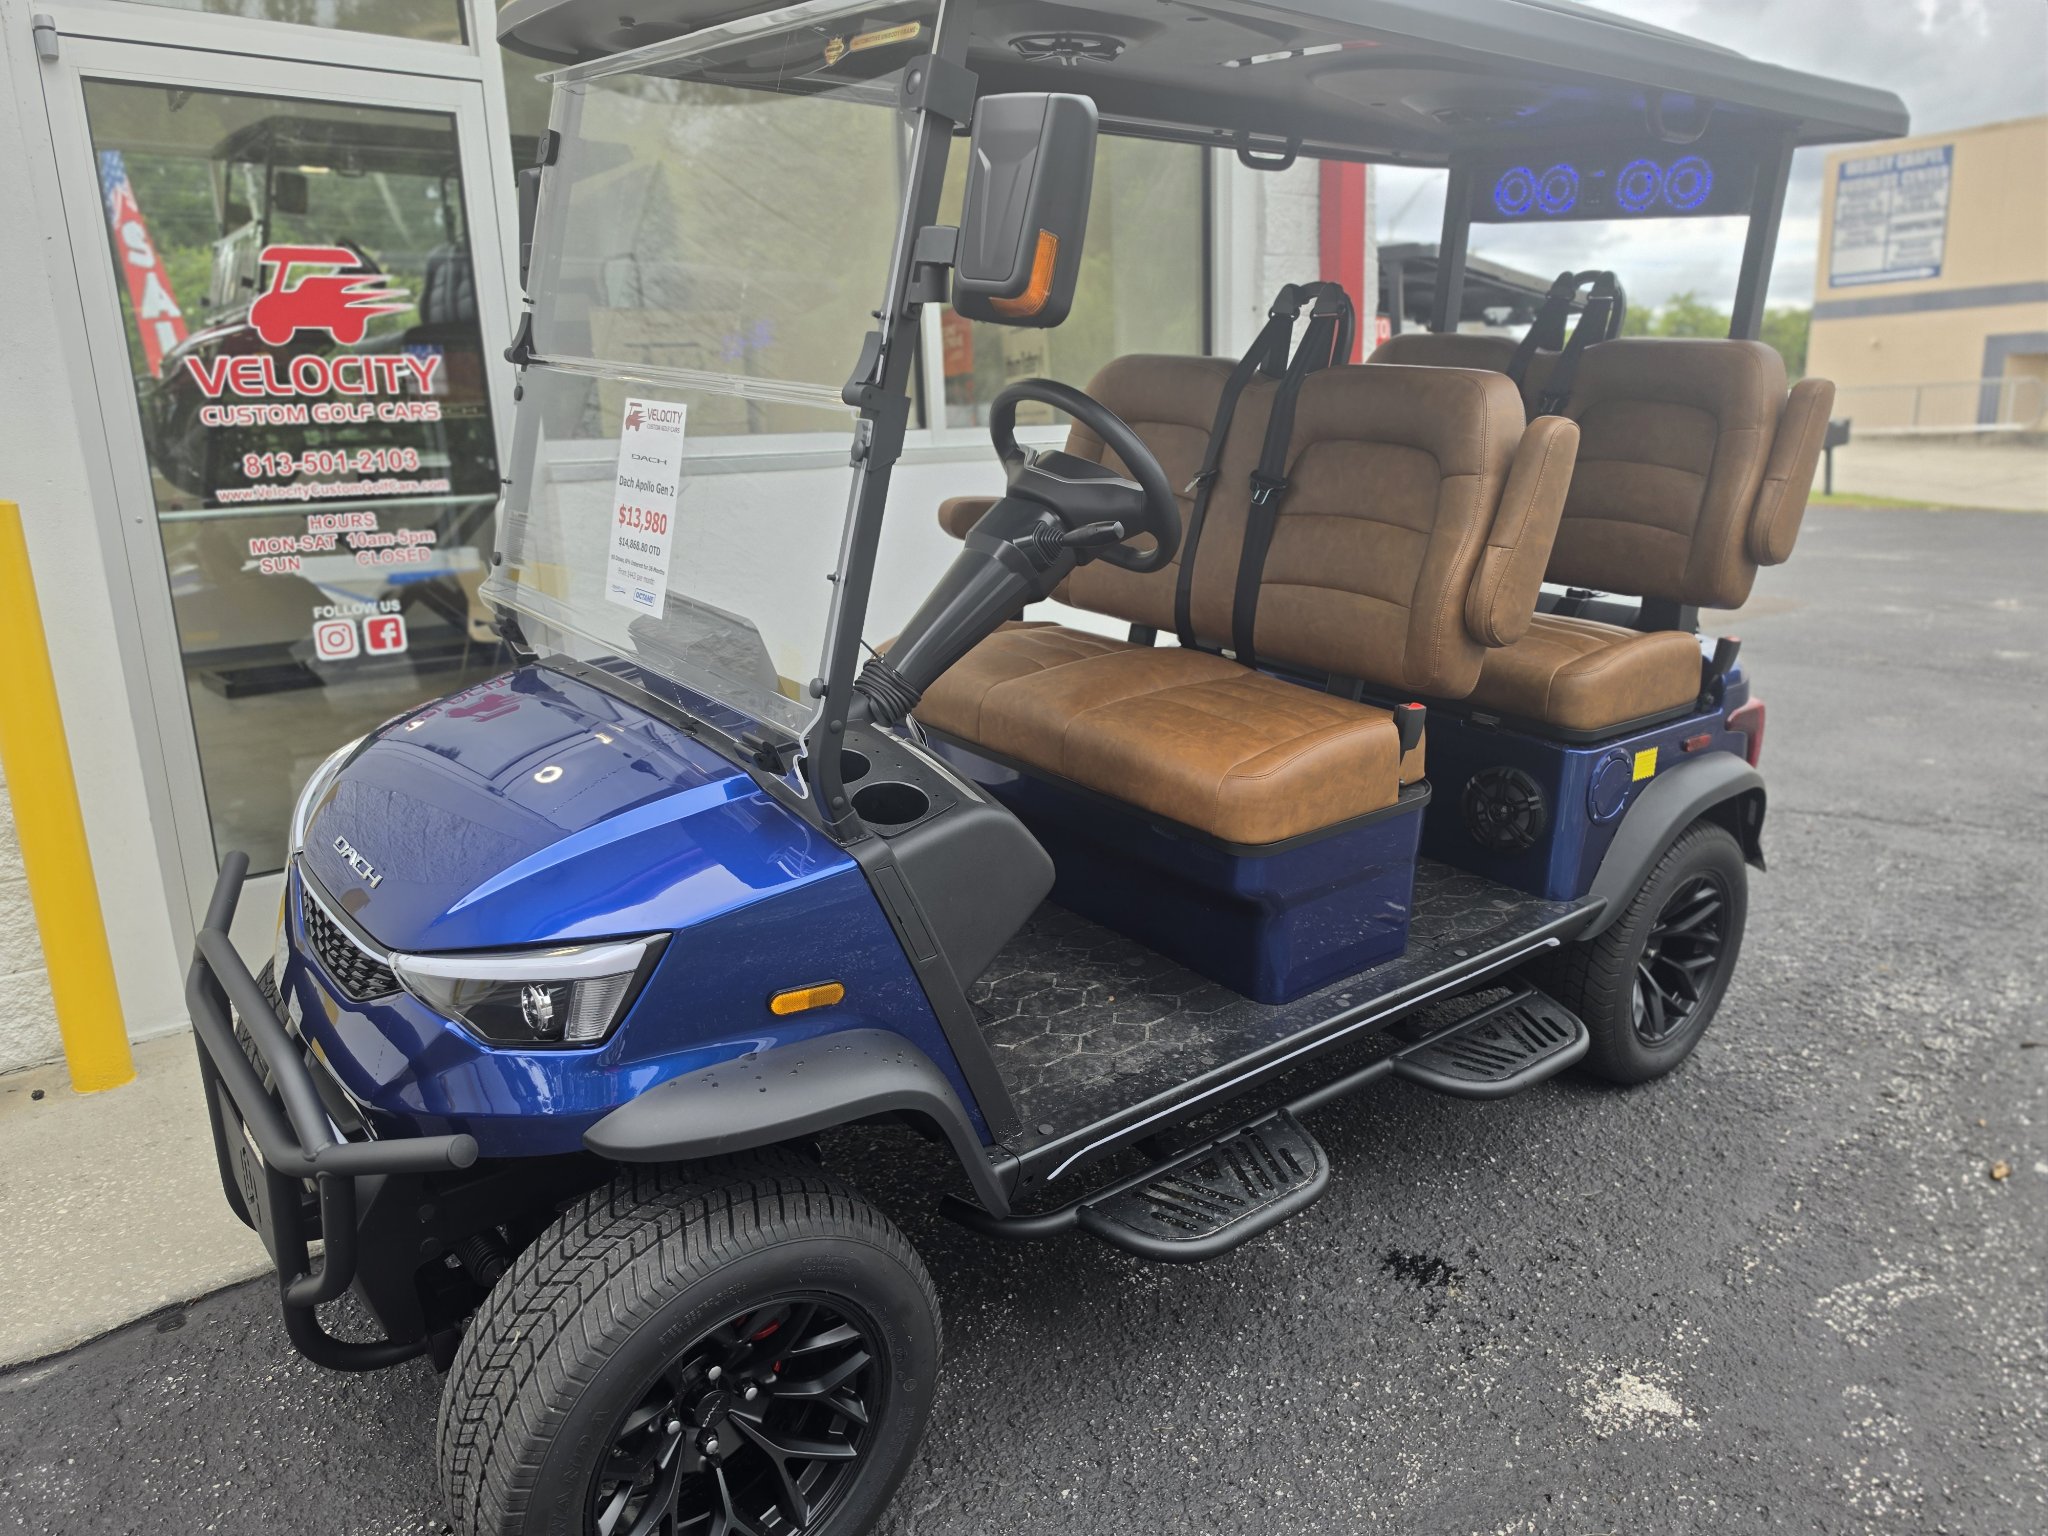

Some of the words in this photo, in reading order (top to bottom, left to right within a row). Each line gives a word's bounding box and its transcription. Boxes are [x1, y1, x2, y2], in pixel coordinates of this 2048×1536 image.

[184, 354, 442, 398] VELOCITY
[199, 403, 309, 426] CUSTOM
[312, 402, 375, 424] GOLF
[377, 401, 441, 422] CARS
[647, 407, 683, 425] VELOCITY
[243, 447, 420, 478] 813-501-2103
[631, 453, 667, 465] DACH
[215, 478, 450, 502] www.VelocityCustomGolfCars.com
[619, 475, 634, 488] Dach
[635, 478, 655, 493] Apollo
[656, 483, 669, 497] Gen
[669, 485, 675, 497] 2
[308, 511, 377, 533] HOURS
[618, 503, 667, 535] $13,980
[250, 533, 338, 556] MON-SAT
[346, 528, 436, 550] 10am-5pm
[648, 544, 661, 557] OTD
[260, 555, 302, 574] SUN
[355, 546, 432, 567] CLOSED
[313, 601, 378, 619] FOLLOW
[380, 599, 401, 613] US
[635, 591, 654, 604] OCTANE
[333, 835, 383, 889] DACH
